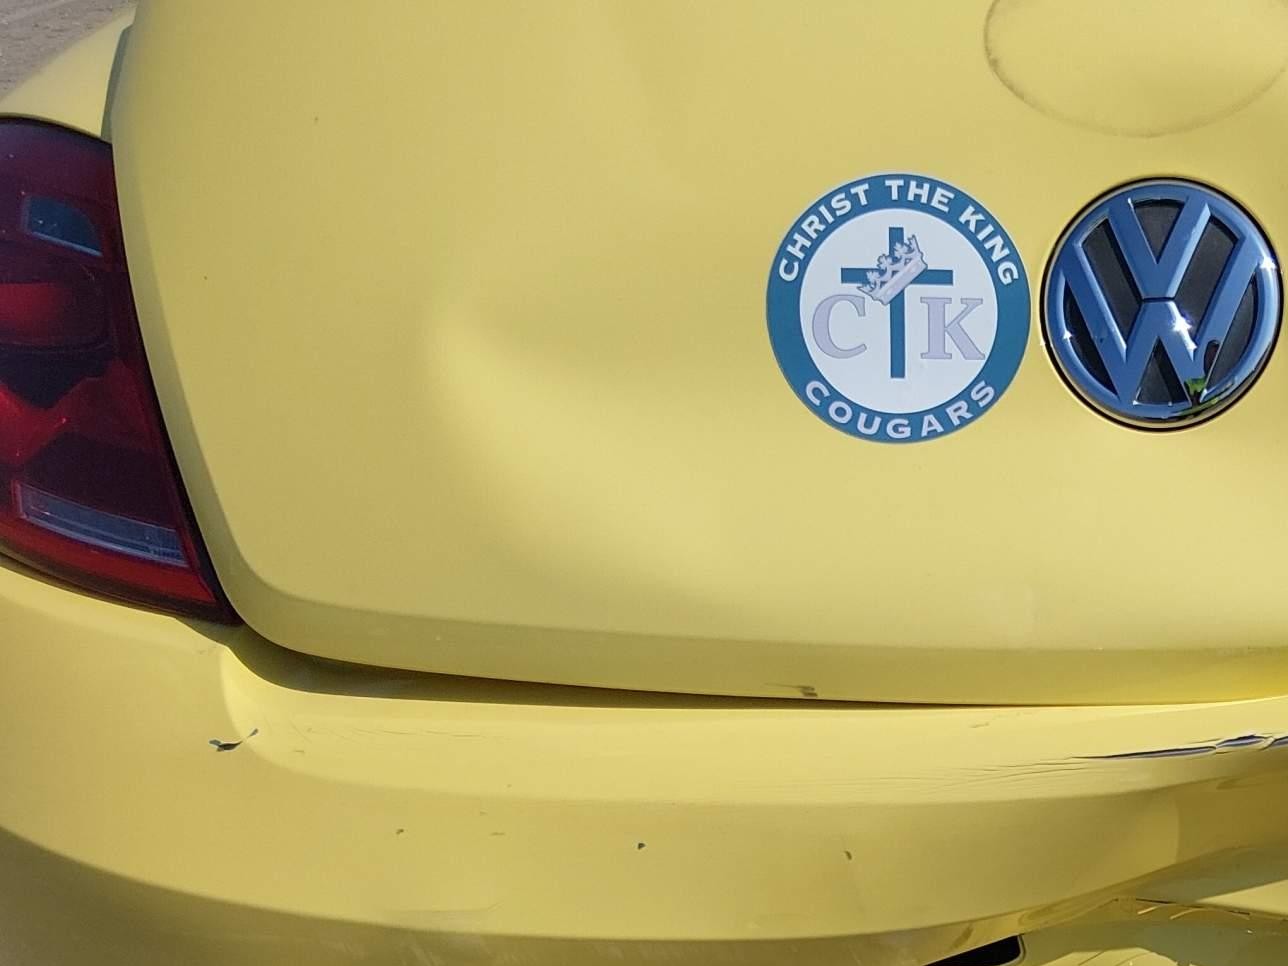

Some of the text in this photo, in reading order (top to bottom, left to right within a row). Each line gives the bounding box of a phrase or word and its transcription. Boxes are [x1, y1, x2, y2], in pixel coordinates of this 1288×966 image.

[778, 179, 1019, 285] CHRIST THE KING
[1050, 184, 1274, 418] VW
[805, 380, 995, 439] COUGARS
